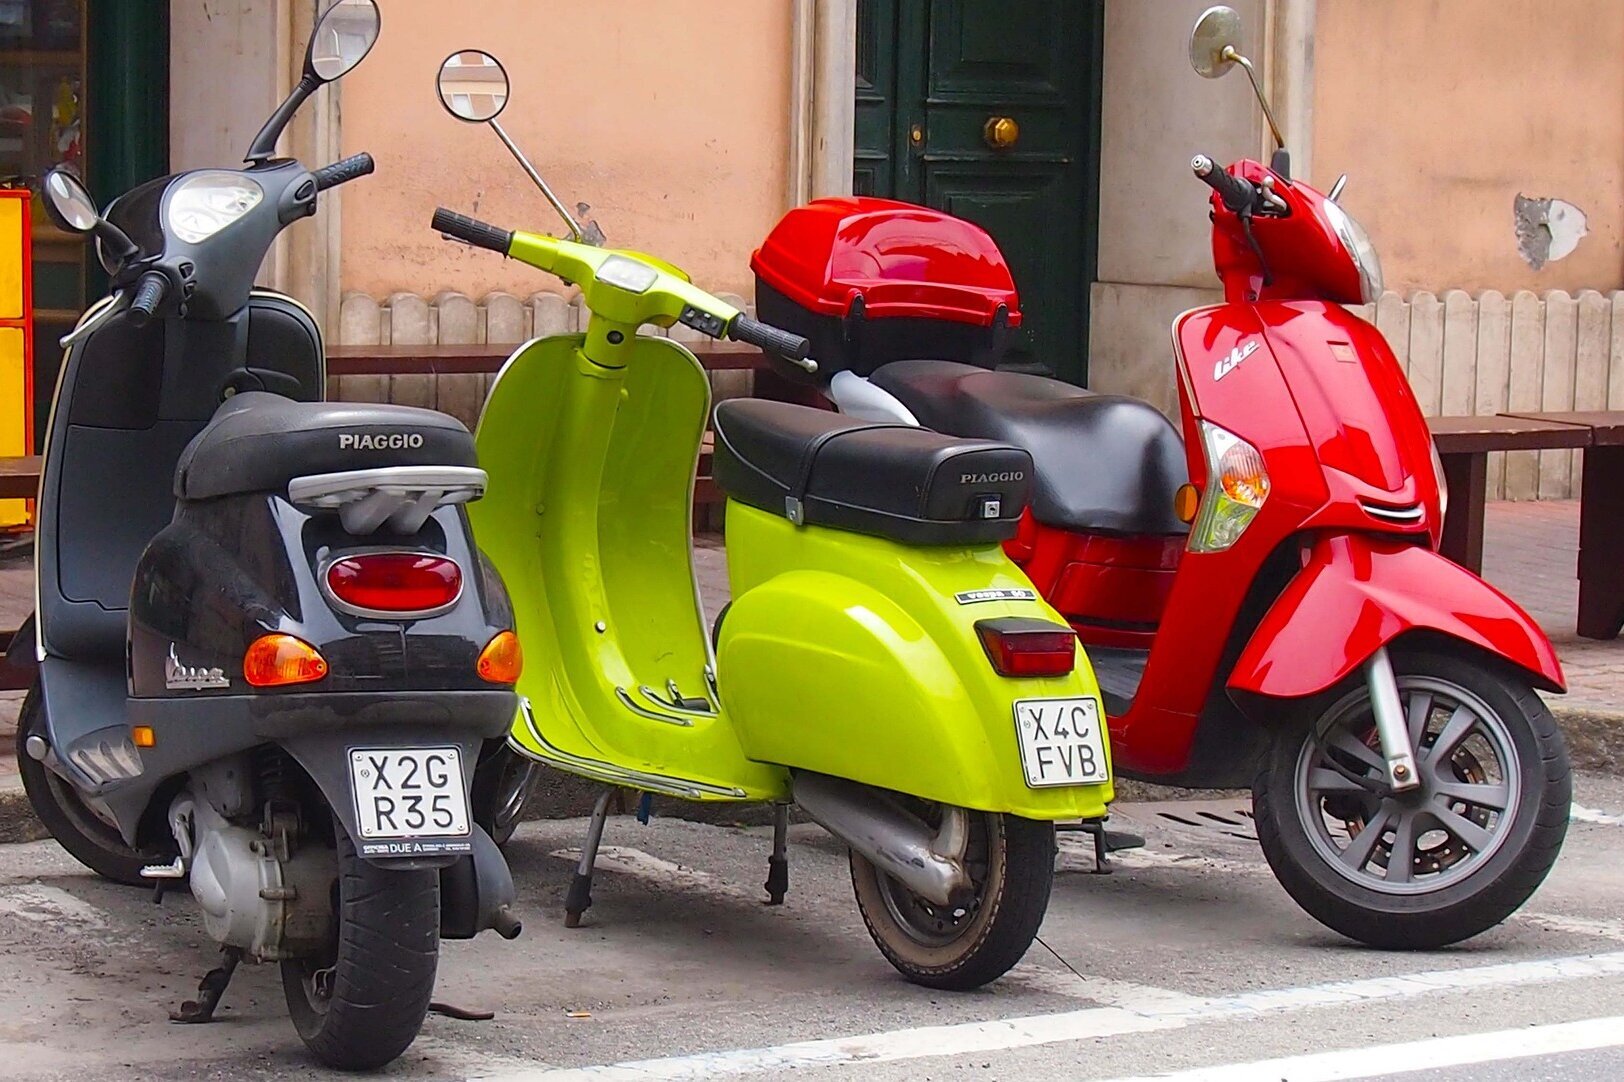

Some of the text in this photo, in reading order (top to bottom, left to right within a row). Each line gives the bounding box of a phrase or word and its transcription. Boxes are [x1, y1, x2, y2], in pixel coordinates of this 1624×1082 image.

[338, 433, 424, 450] PIAGGIO
[960, 471, 1024, 484] PIAGGIO
[1028, 706, 1089, 741] X4C
[368, 755, 449, 790] X2G
[1036, 744, 1096, 779] FVB
[373, 795, 453, 831] R35
[389, 843, 412, 853] DUE
[413, 843, 422, 853] A
